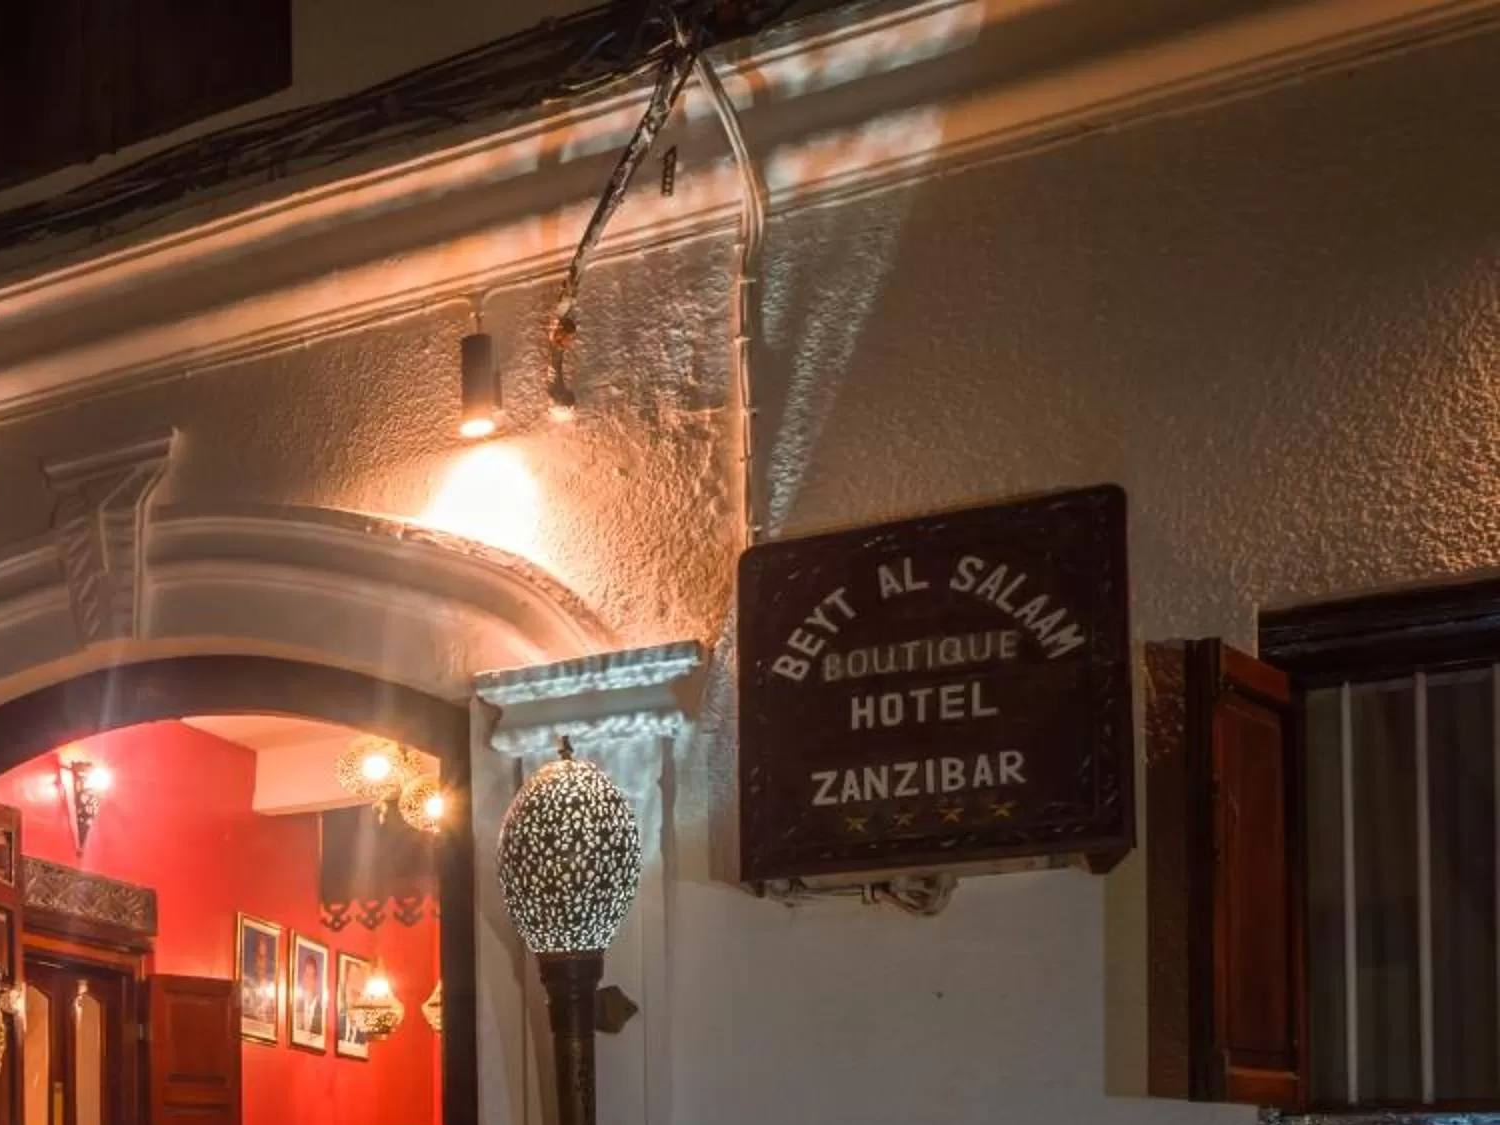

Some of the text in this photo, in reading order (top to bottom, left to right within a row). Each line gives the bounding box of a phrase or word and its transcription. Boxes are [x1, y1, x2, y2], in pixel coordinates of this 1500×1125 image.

[772, 554, 1087, 683] BEYT AL SALAAM
[822, 629, 1022, 683] BOUTIQUE
[850, 681, 1000, 731] HOTEL
[810, 750, 1028, 806] ZANZIBAR
